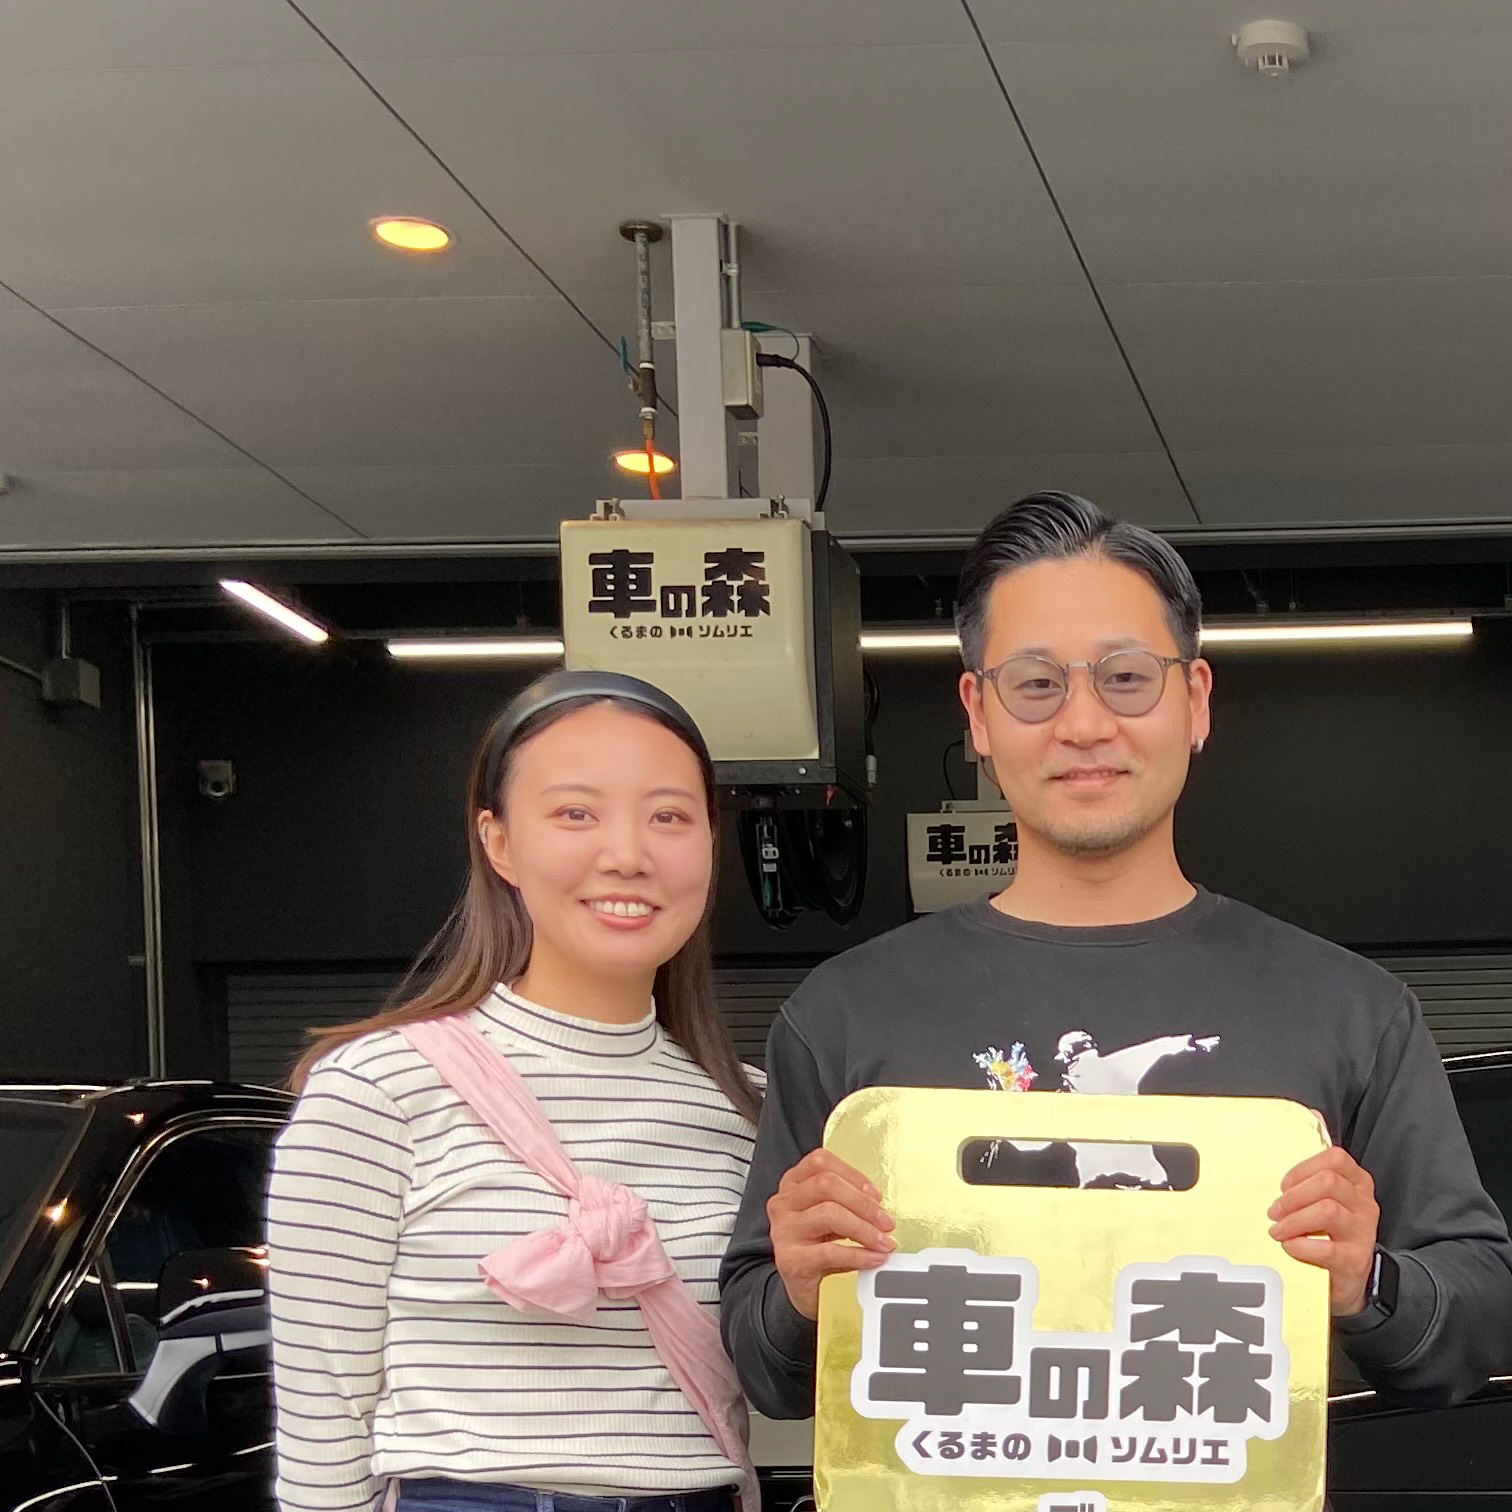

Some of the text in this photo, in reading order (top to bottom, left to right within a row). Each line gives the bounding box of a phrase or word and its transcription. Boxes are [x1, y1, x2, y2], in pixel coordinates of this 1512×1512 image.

[588, 548, 770, 618] 車の森
[609, 625, 753, 639] くるまの ソムリエ
[868, 1265, 1272, 1423] 車の森
[912, 1431, 1229, 1465] くるまの ソムリエ
